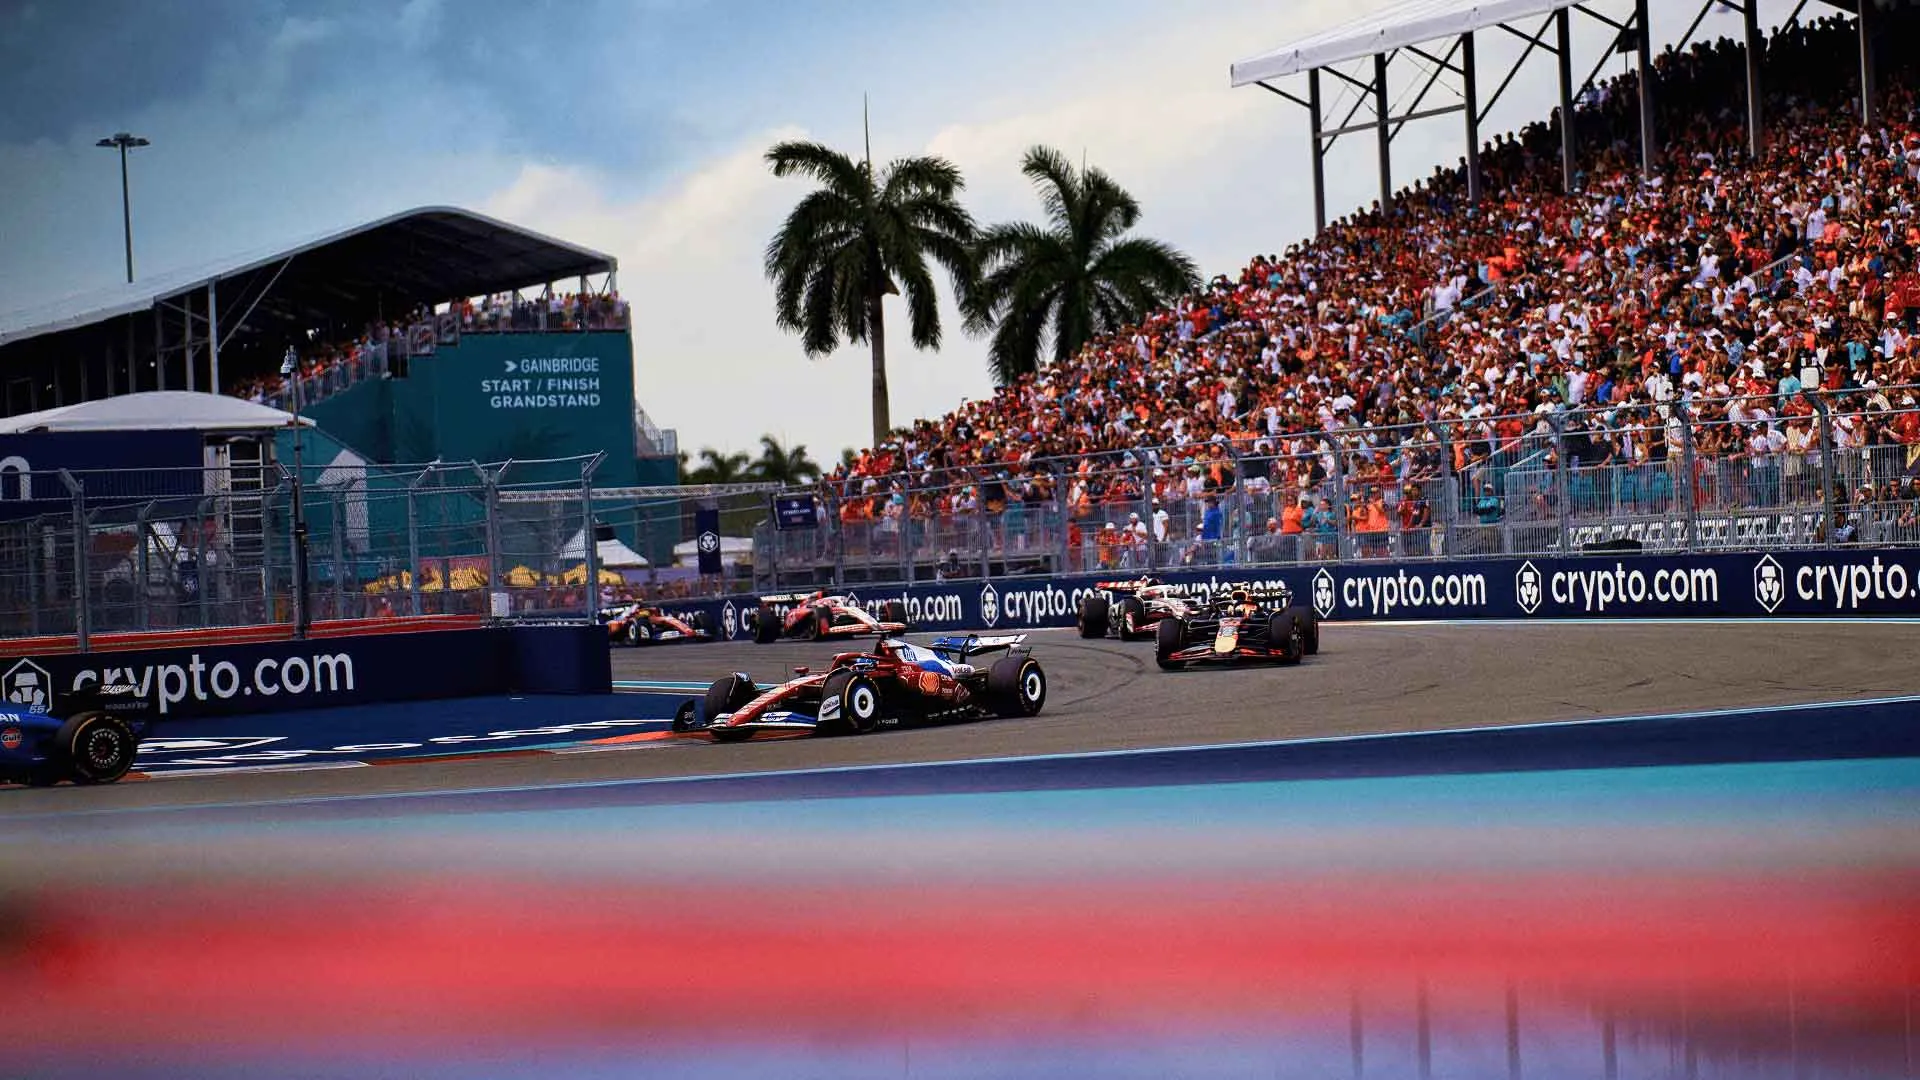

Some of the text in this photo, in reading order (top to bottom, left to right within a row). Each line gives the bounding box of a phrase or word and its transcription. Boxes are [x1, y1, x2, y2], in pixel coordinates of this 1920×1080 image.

[520, 358, 599, 373] GAINBRIDGE
[481, 379, 531, 392] START
[547, 378, 600, 391] FINISH
[490, 394, 601, 409] GRANDSTAND
[1551, 562, 1719, 612] crypto.com
[1796, 556, 1920, 609] crypto.
[1343, 569, 1486, 615] crypto.com
[28, 705, 46, 714] 55
